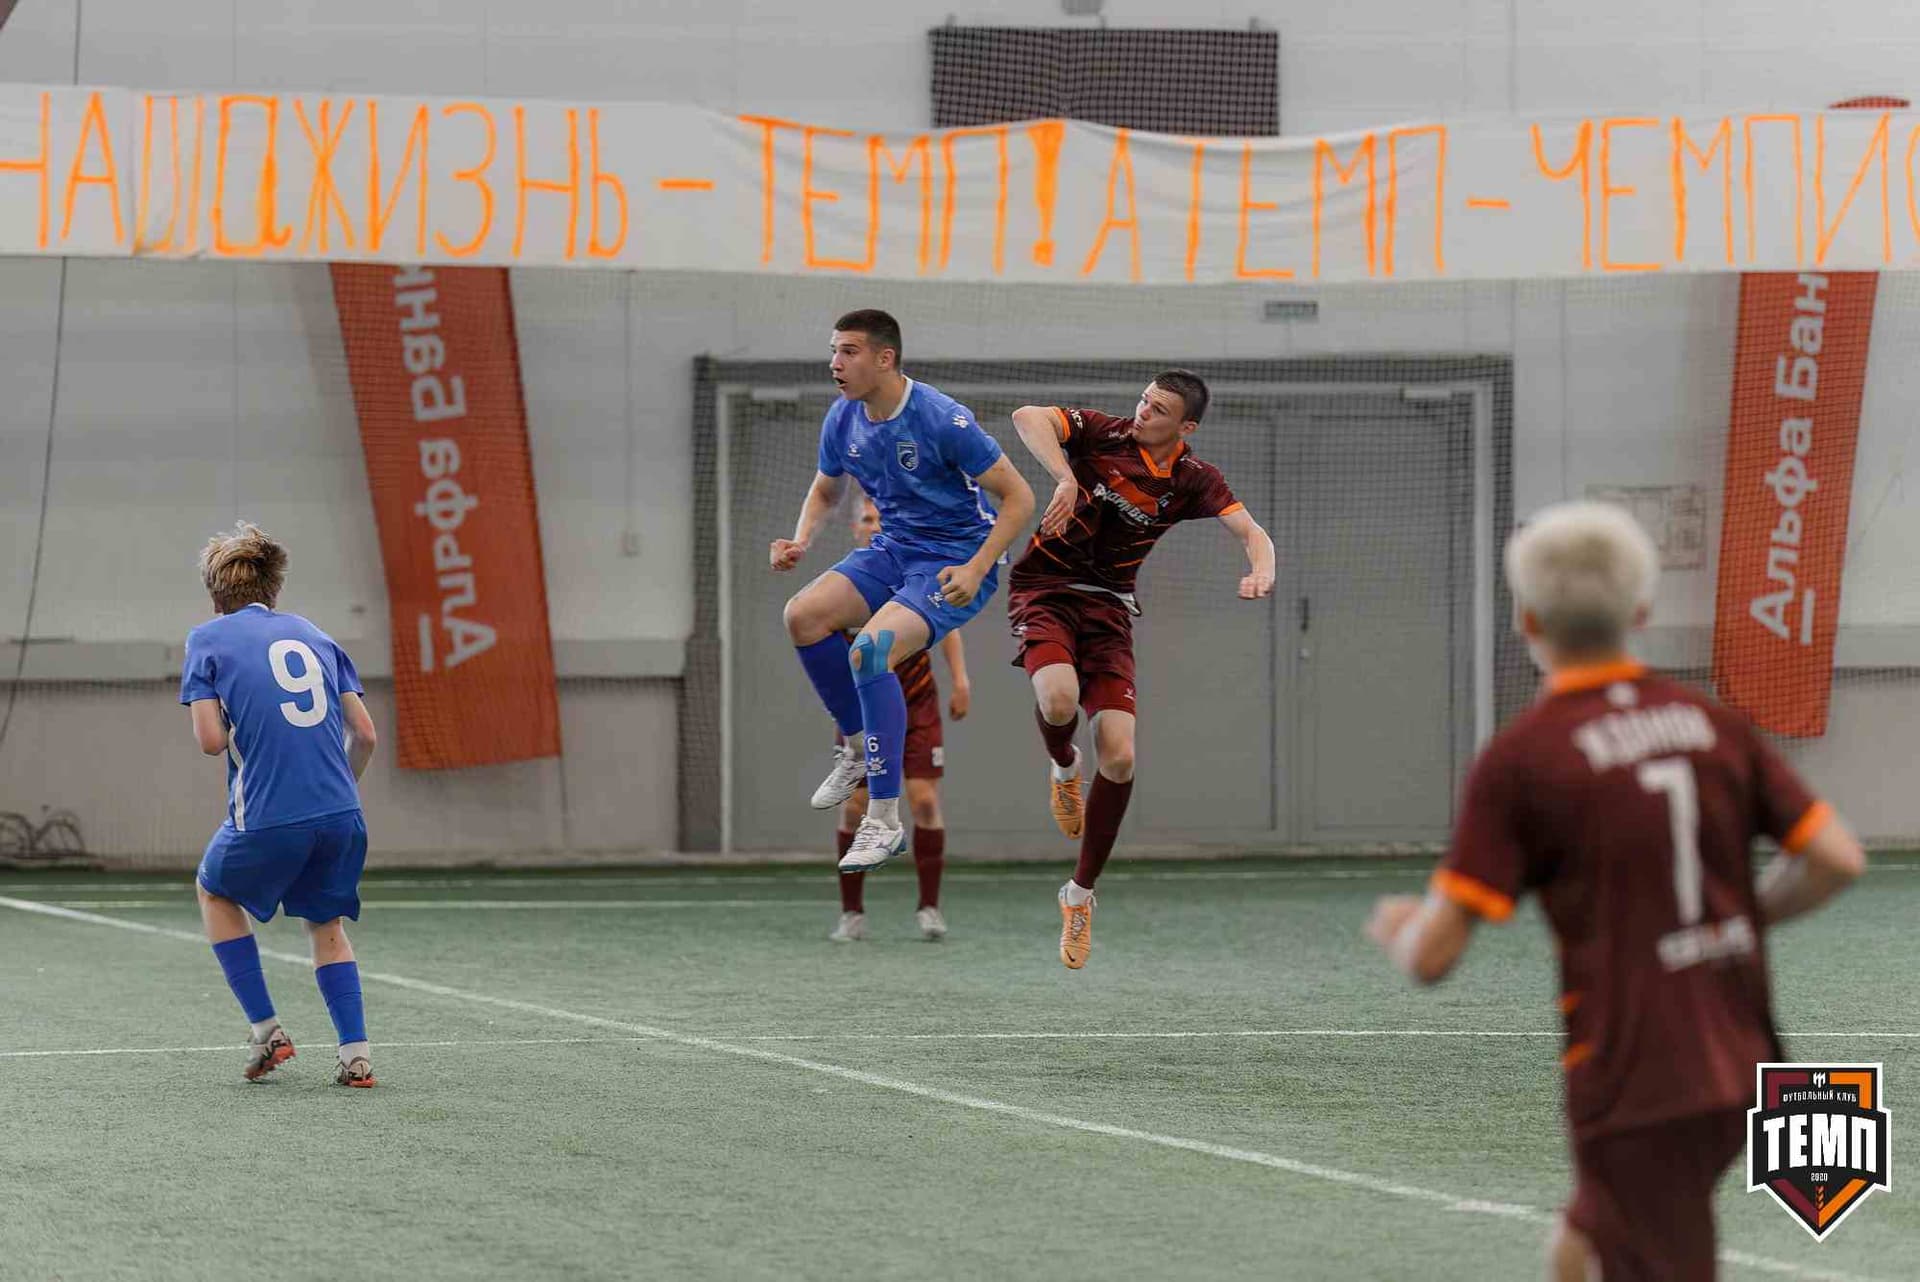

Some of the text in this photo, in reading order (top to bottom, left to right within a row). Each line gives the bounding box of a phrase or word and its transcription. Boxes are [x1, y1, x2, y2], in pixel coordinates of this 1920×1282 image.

[292, 97, 629, 262] ЖИЗНЬ
[736, 114, 1066, 276] ТЕМП!
[1750, 416, 1817, 646] Альфа
[269, 639, 328, 728] 9
[867, 736, 879, 753] 6
[1637, 756, 1704, 926] 7
